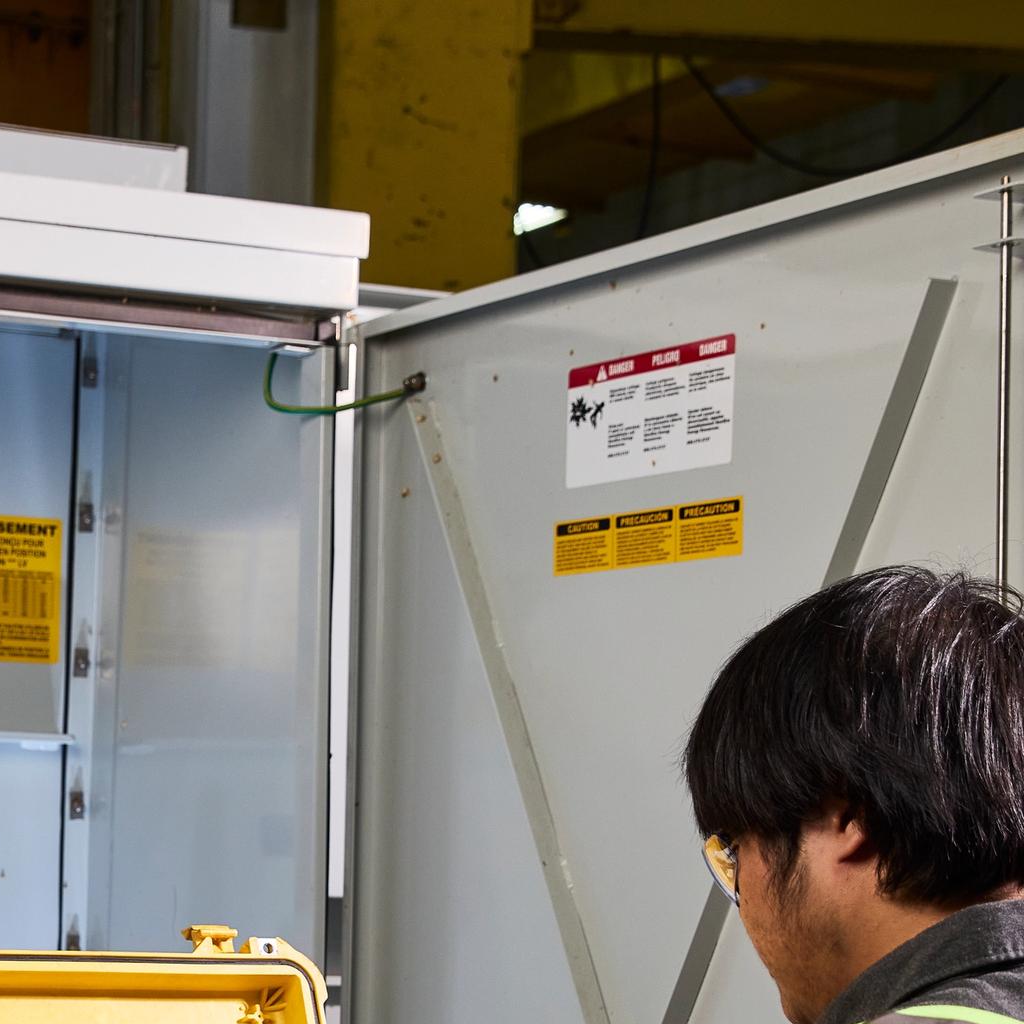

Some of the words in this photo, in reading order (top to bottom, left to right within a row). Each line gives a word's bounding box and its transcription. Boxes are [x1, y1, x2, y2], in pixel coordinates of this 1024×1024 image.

[699, 339, 727, 356] DANGER
[652, 350, 680, 367] PELIGRO
[608, 360, 634, 376] DANGER
[567, 522, 600, 534] CAUTION
